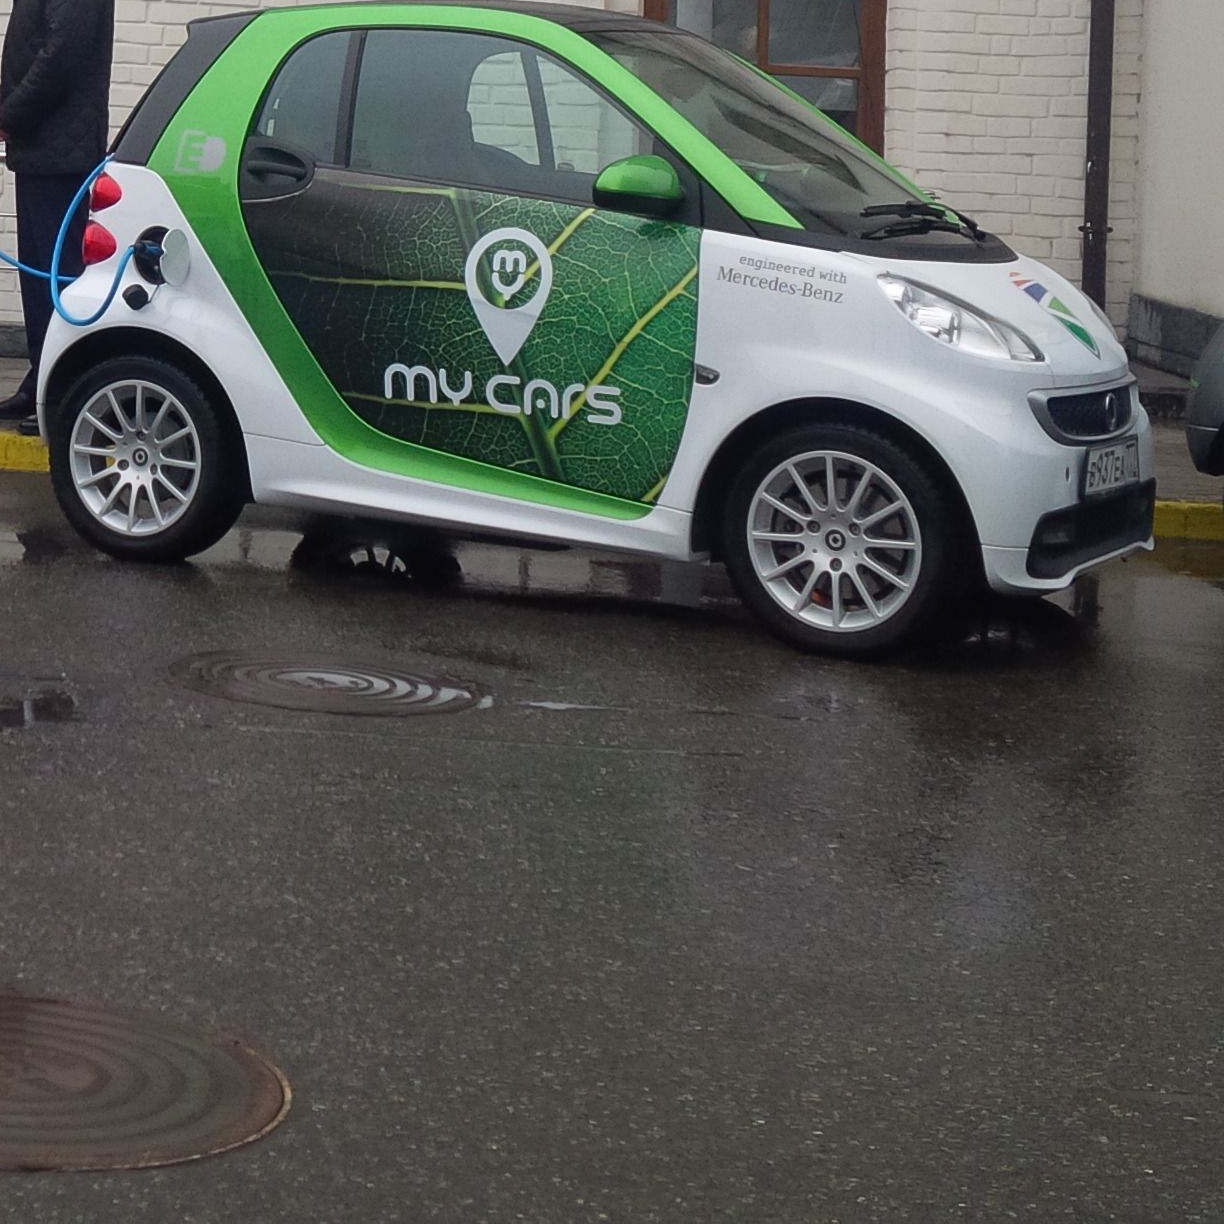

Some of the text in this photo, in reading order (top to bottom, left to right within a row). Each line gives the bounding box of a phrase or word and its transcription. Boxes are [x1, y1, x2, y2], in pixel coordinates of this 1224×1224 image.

[716, 265, 844, 304] Mercedes-Benz
[739, 256, 847, 285] engineered with
